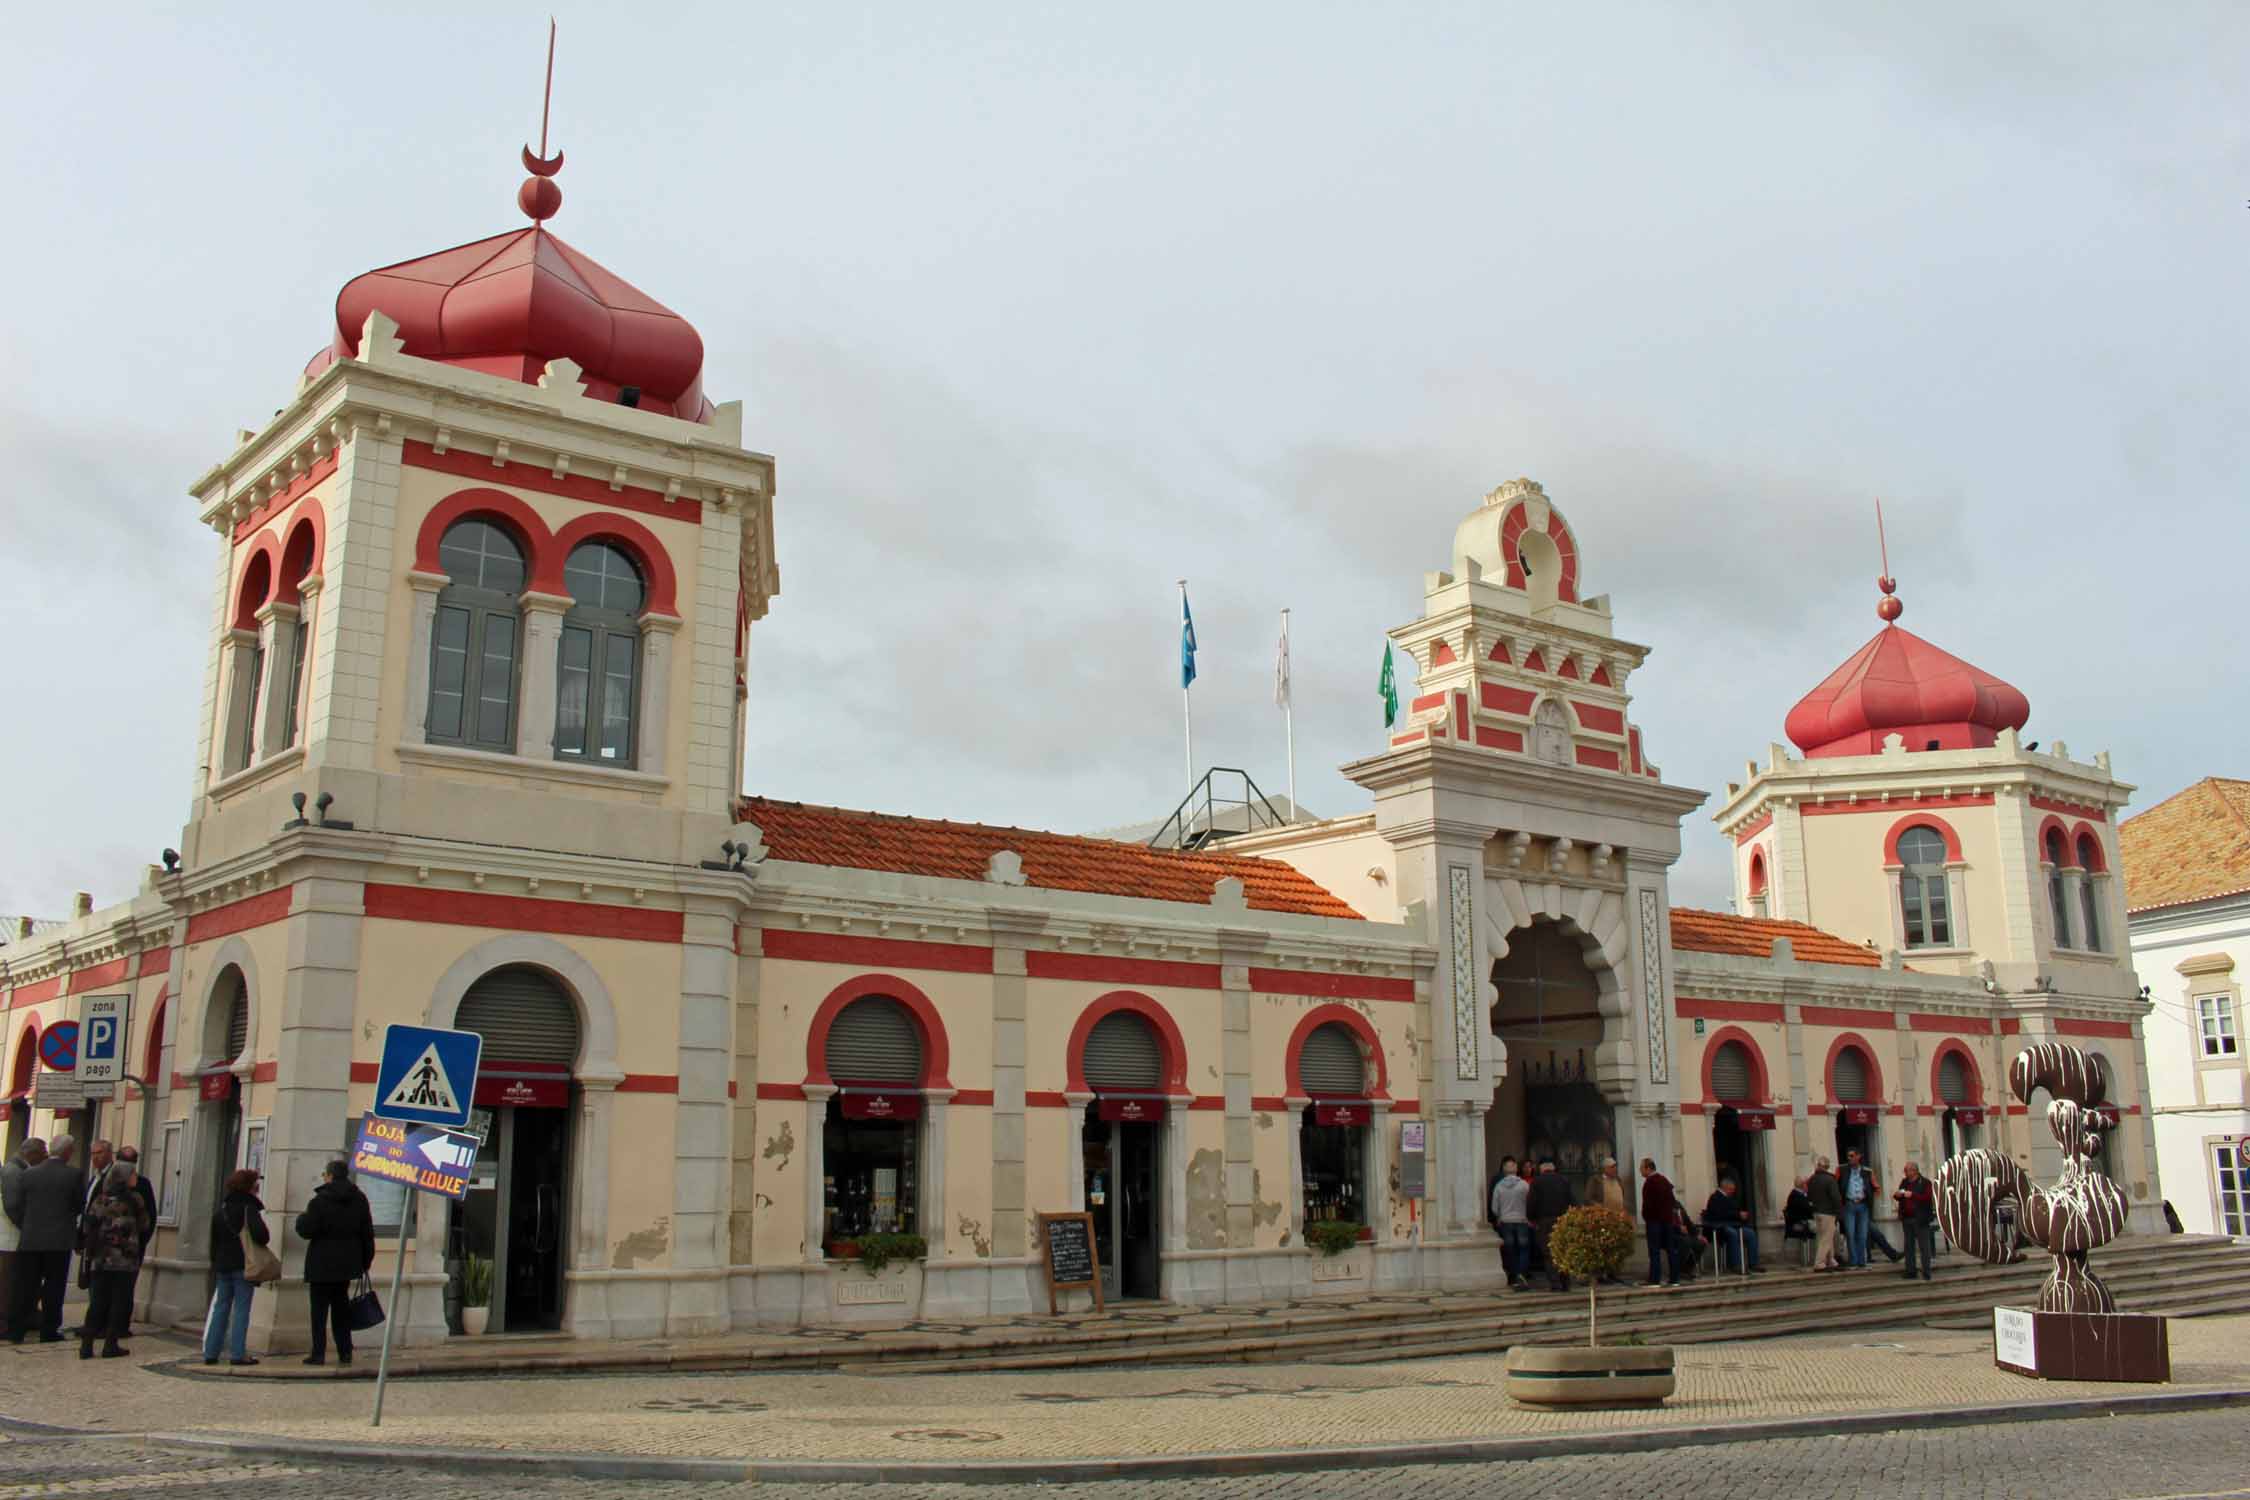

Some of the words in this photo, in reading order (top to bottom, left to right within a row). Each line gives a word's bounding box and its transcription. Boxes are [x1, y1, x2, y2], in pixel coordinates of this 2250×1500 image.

[92, 1002, 115, 1012] zona
[90, 1020, 112, 1056] P
[86, 1065, 111, 1076] pago
[367, 1120, 405, 1143] LOJA
